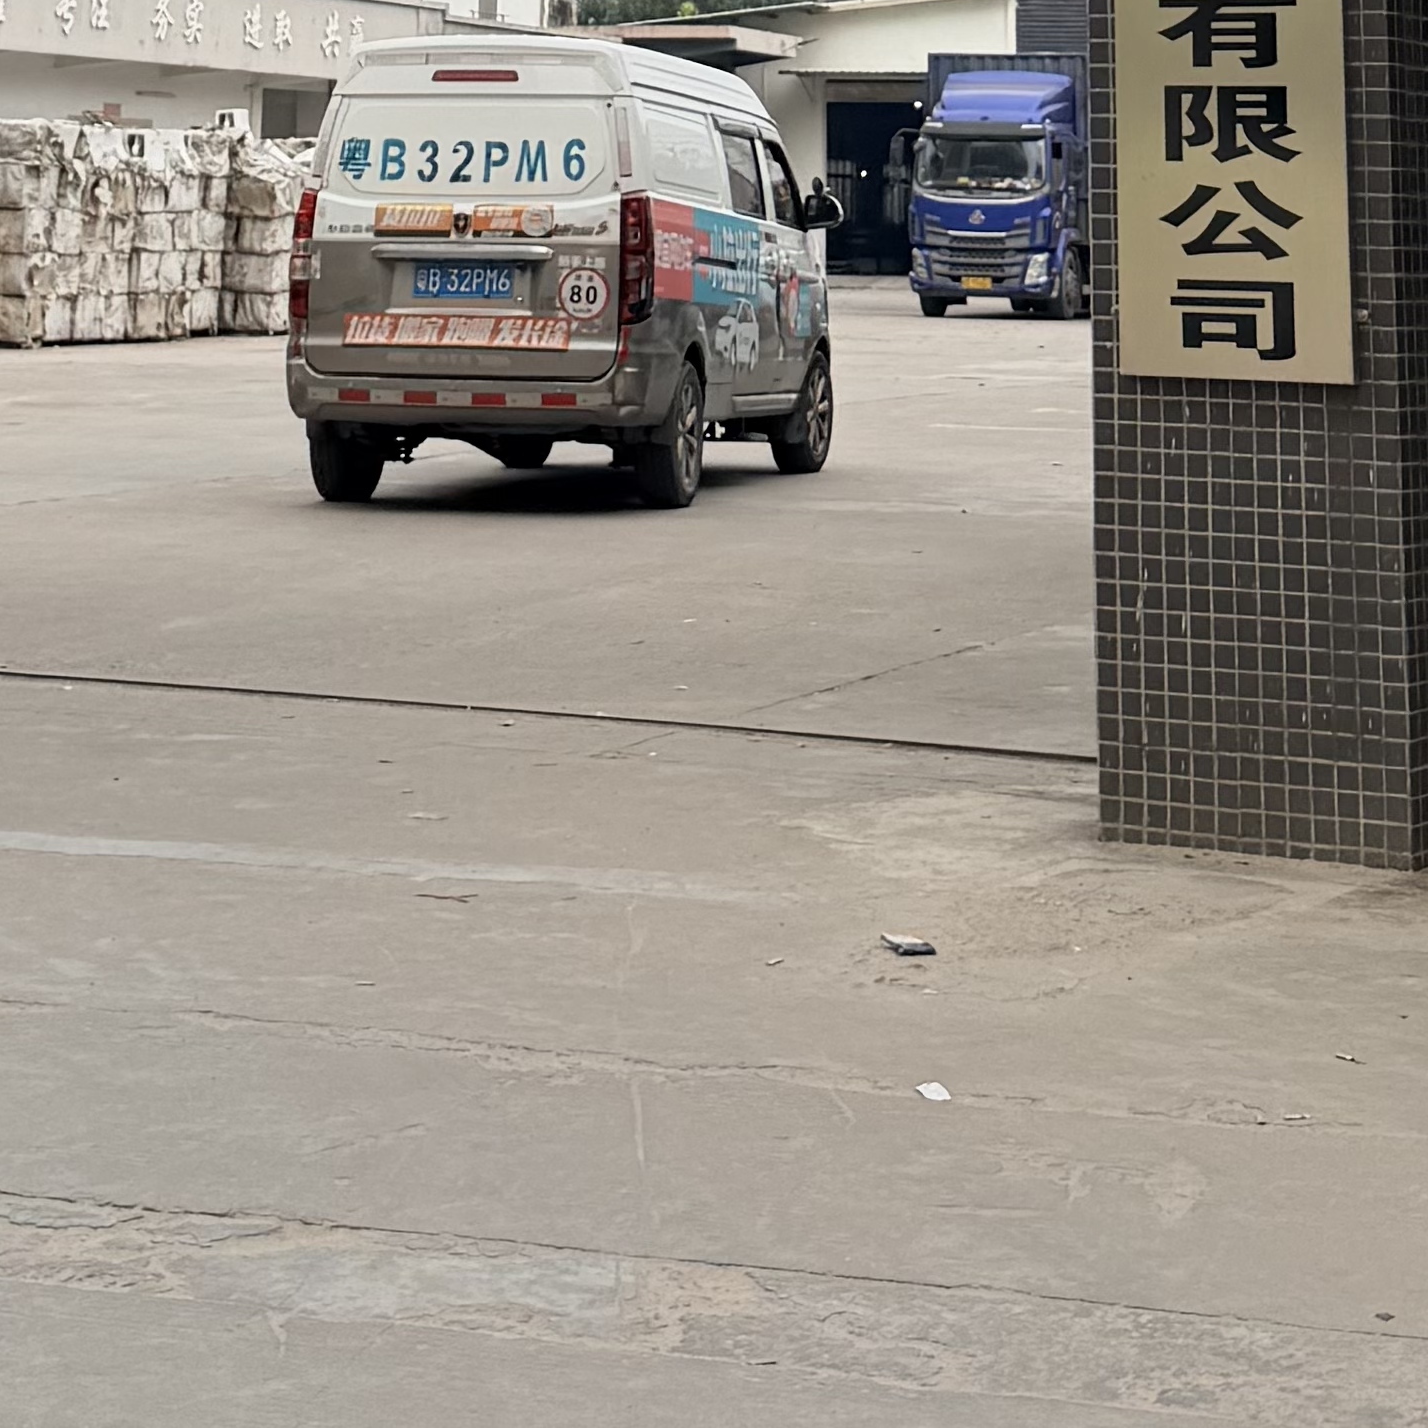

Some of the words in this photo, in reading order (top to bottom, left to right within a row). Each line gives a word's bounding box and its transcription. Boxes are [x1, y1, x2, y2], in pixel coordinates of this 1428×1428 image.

[243, 3, 293, 52] 进取
[338, 137, 586, 182] 粤B32PM6
[569, 284, 598, 305] 80
